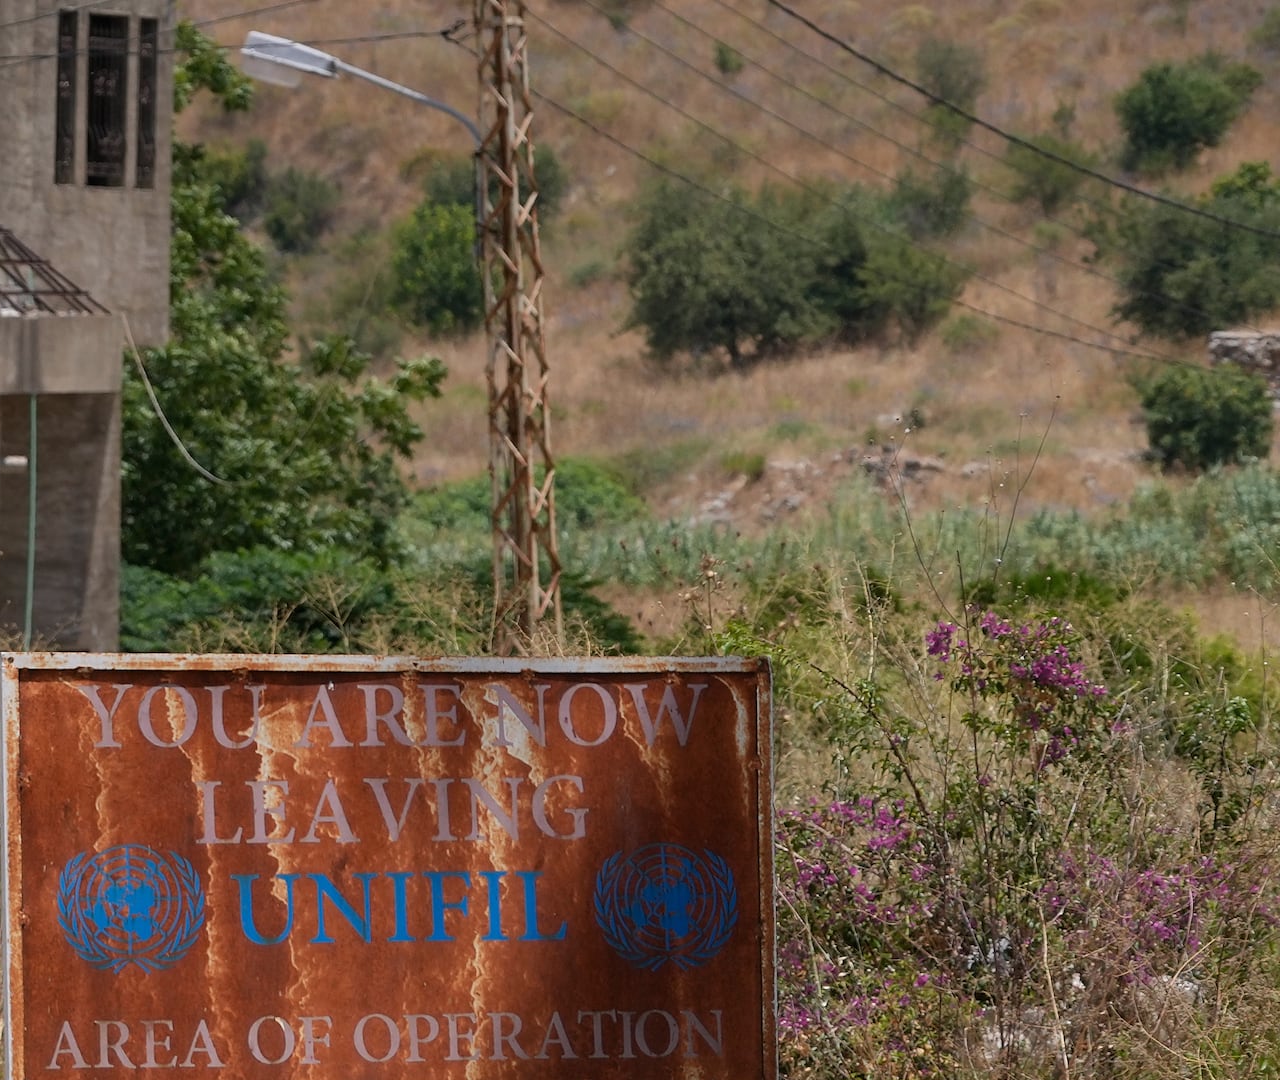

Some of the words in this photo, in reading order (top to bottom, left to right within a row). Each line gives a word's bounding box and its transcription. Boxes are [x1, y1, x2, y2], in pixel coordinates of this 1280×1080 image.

[78, 684, 266, 750] YOU
[296, 684, 467, 748] ARE
[495, 682, 711, 748] NOW
[195, 774, 588, 846] LEAVING
[231, 868, 568, 945] UNIFIL
[45, 1018, 225, 1070] AREA
[247, 1014, 333, 1068] OF
[353, 1008, 725, 1064] OPERATION
